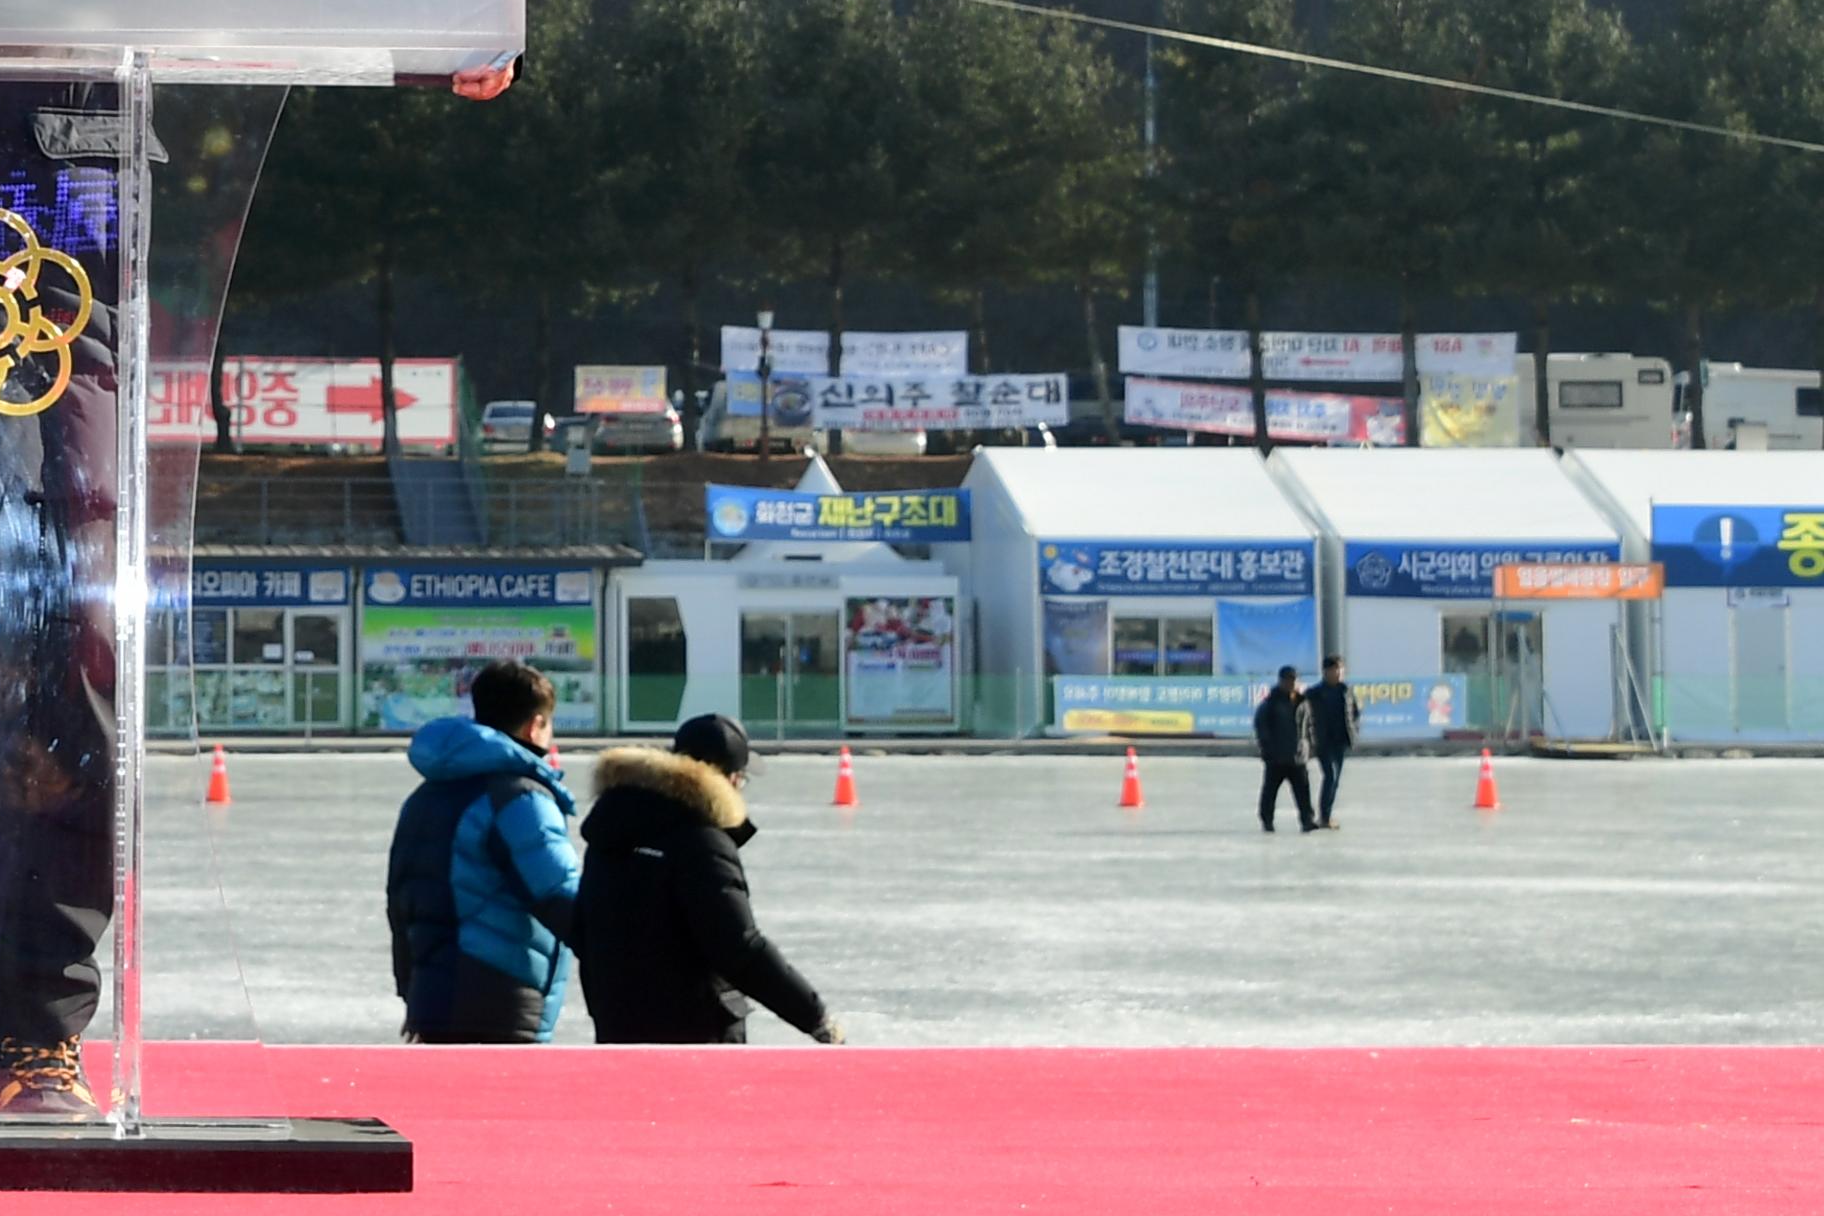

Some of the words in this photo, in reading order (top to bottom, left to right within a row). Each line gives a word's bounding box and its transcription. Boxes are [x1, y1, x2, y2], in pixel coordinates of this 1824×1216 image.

[820, 381, 932, 409] 신의주
[755, 500, 815, 525] 화천군
[817, 495, 957, 528] 재난구조대
[1098, 549, 1233, 581] 조경철천문대
[1236, 549, 1305, 581] 홍보관
[1397, 550, 1477, 582] 시군의회
[263, 571, 302, 597] 카페
[410, 574, 498, 599] ETHIOPIA
[500, 574, 551, 598] CAFE
